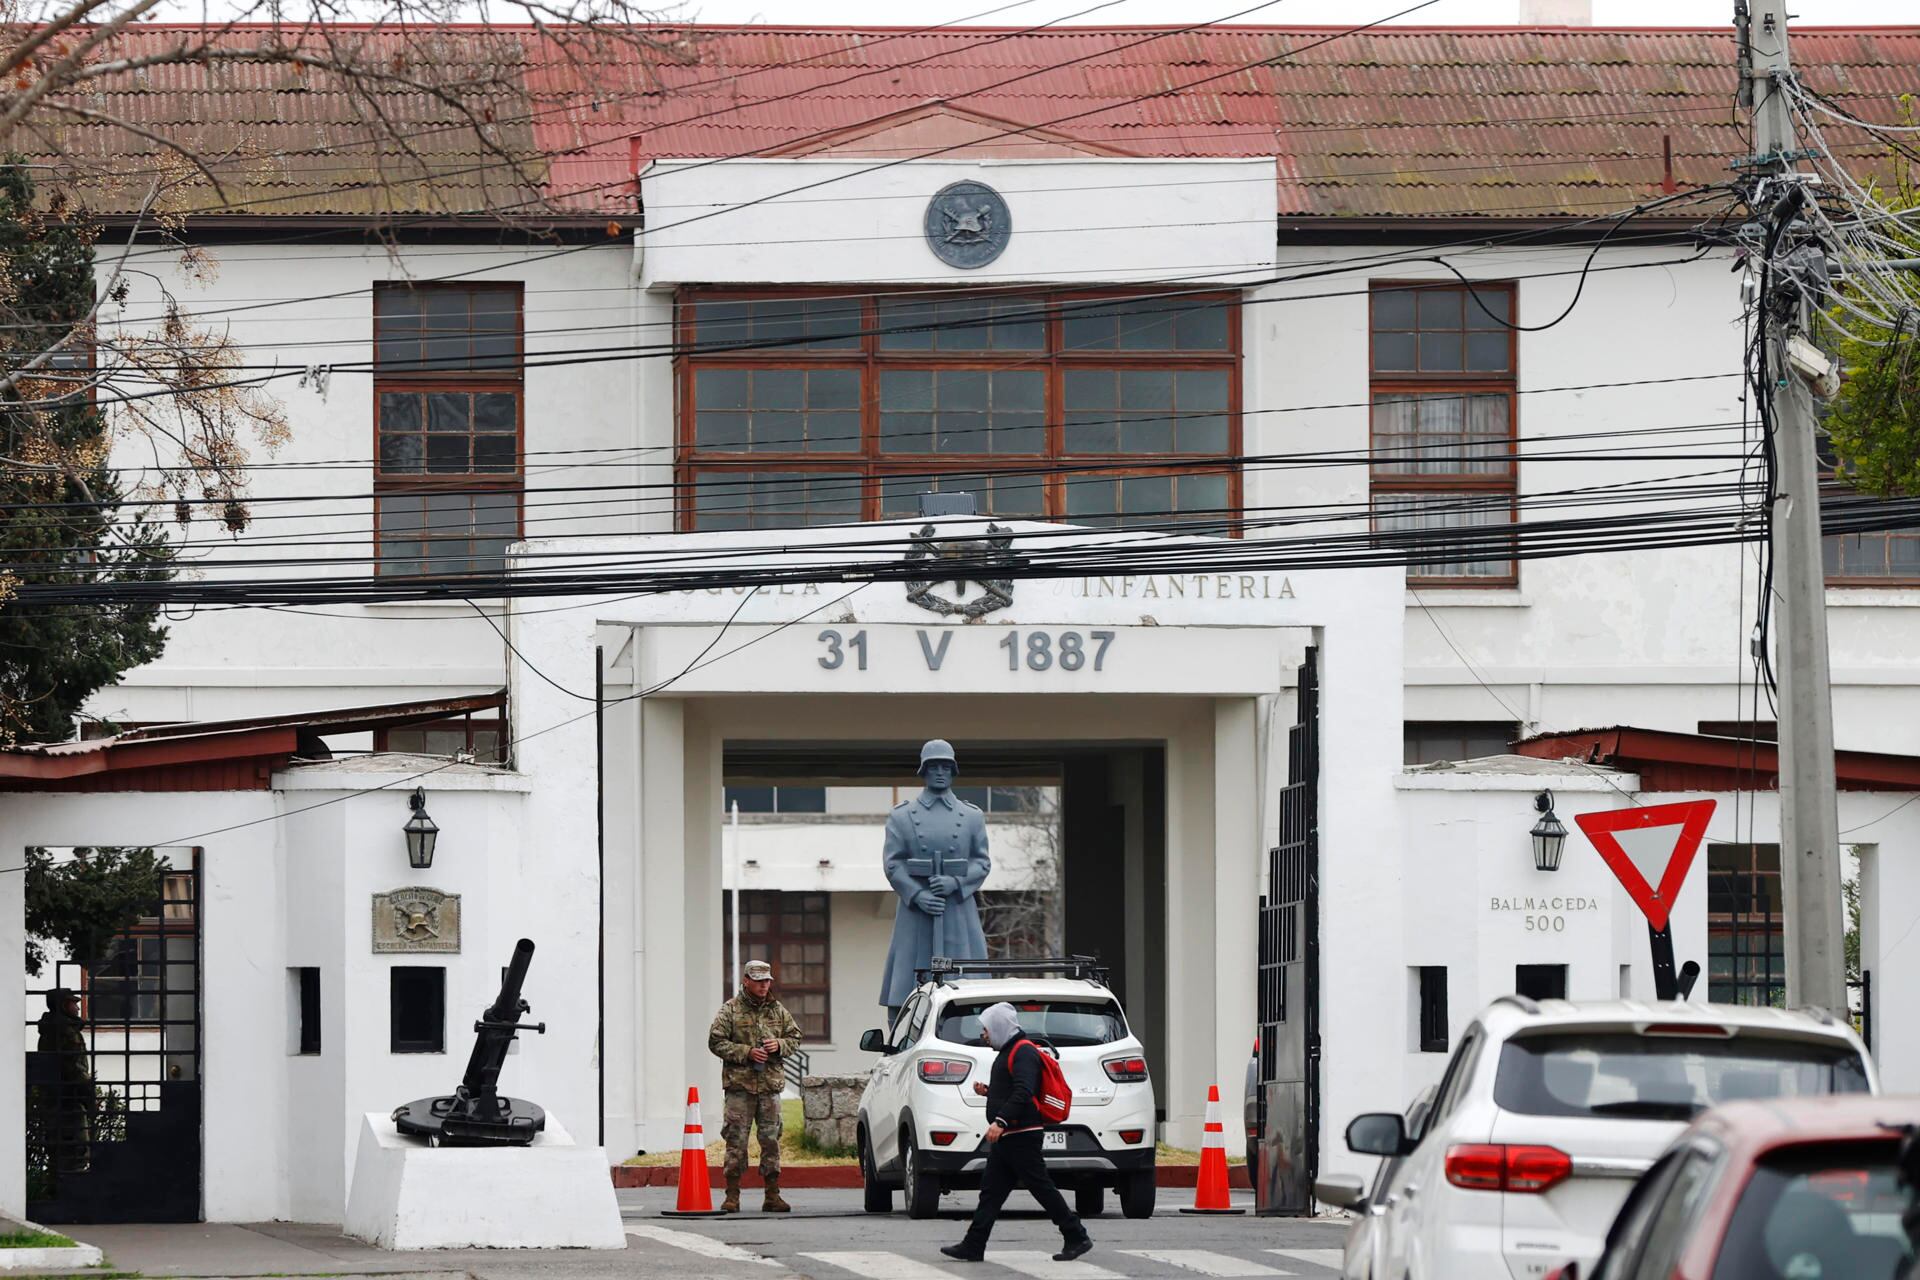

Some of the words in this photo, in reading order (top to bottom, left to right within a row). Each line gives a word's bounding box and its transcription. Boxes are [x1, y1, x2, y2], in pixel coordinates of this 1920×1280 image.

[1081, 574, 1297, 599] INFANTERIA
[817, 629, 868, 670] 31
[916, 629, 954, 671] V
[999, 630, 1116, 671] 1887
[1490, 897, 1598, 911] BALMACEDA
[1525, 915, 1565, 932] 500
[1051, 1132, 1065, 1144] 18
